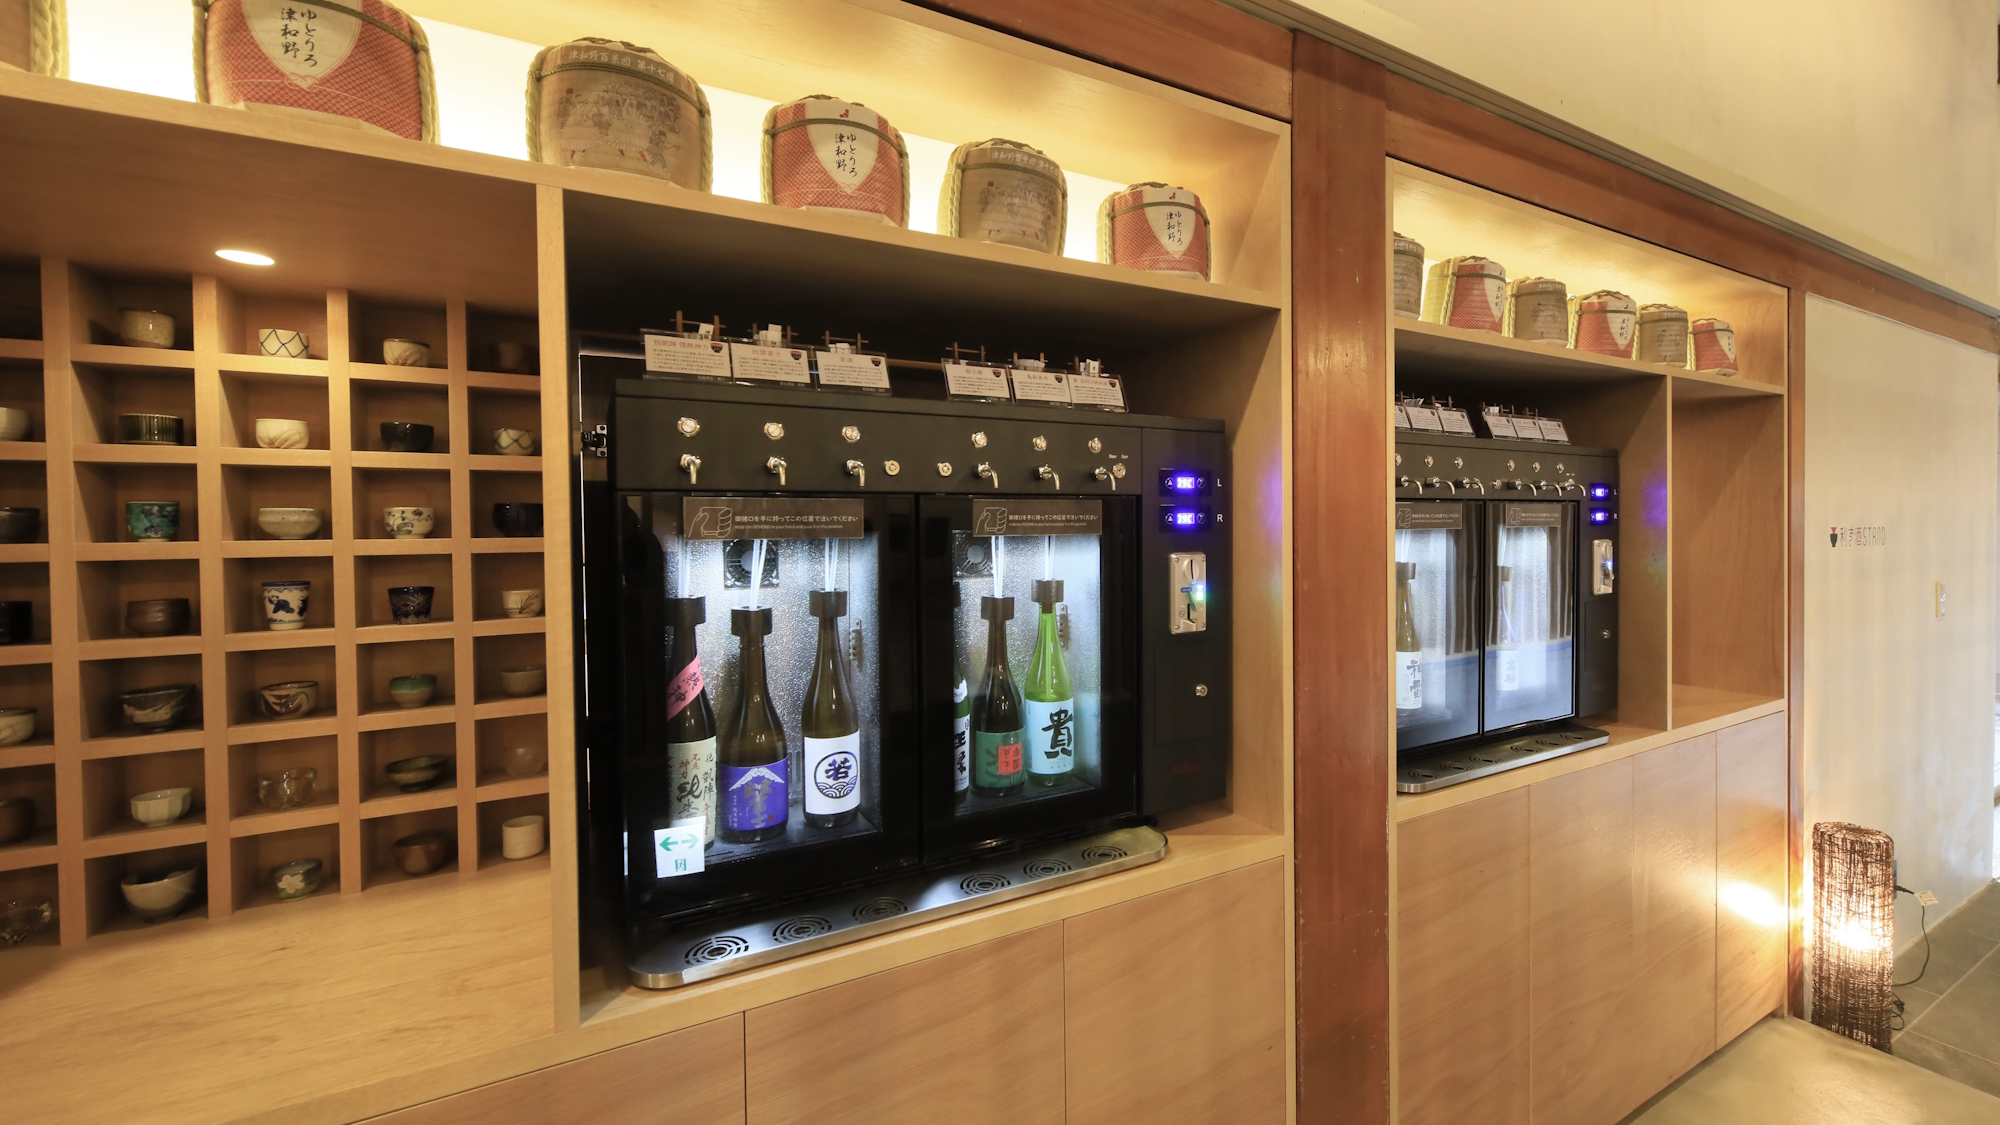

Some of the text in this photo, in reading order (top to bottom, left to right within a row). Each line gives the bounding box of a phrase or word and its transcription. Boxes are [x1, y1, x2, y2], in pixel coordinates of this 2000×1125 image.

[281, 7, 299, 59] 津和野
[300, 8, 317, 67] ゆとりろ
[835, 132, 847, 172] 津和野
[847, 132, 857, 178] ゆとりろ
[1217, 479, 1222, 487] L
[1217, 514, 1223, 522] R
[1041, 708, 1073, 759] 貴
[825, 757, 852, 781] 若
